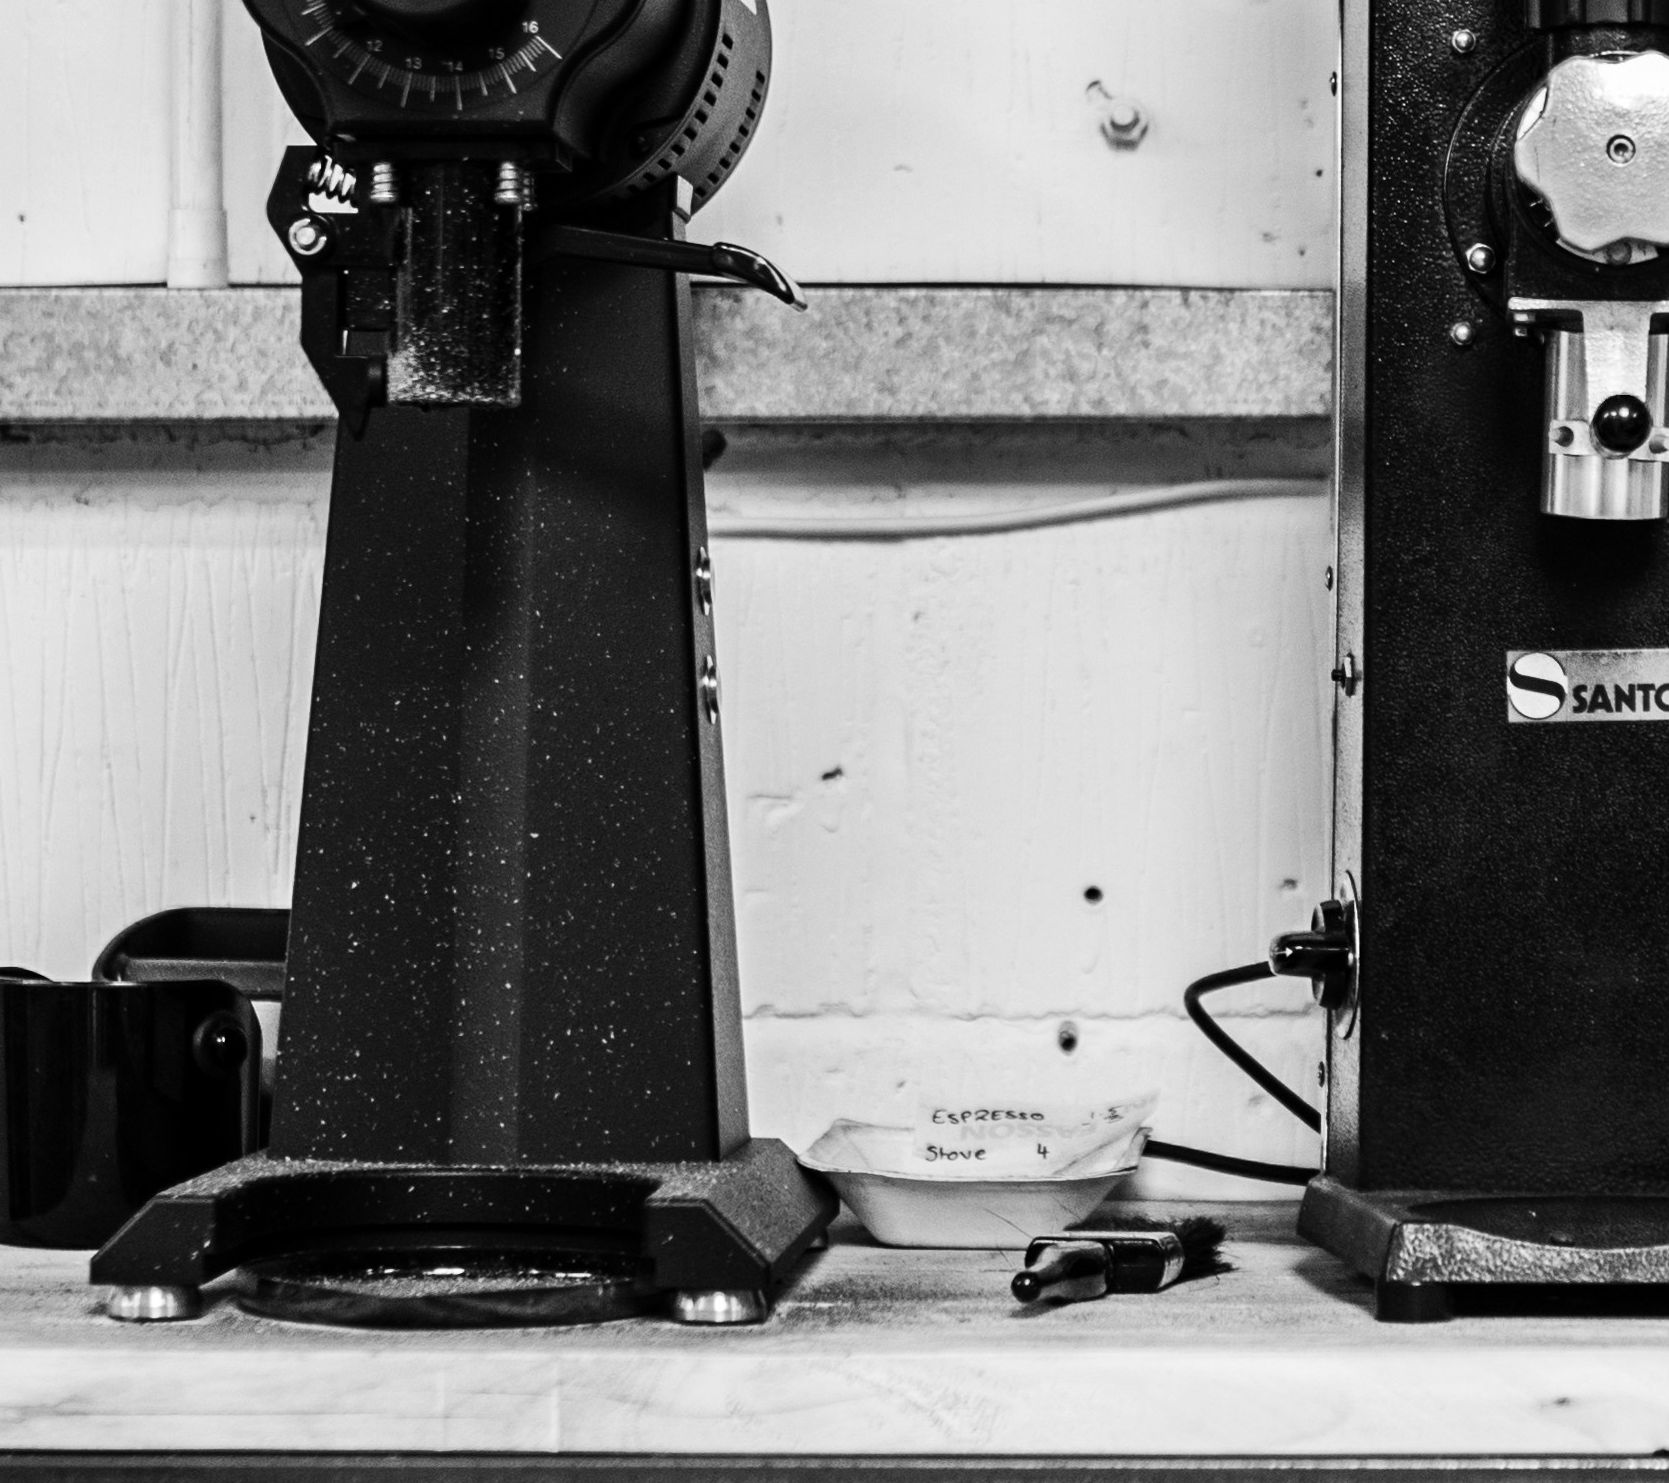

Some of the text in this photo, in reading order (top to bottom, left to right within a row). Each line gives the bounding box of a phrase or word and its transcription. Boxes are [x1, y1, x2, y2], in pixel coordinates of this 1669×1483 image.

[522, 20, 538, 33] 16
[489, 48, 504, 59] 15
[925, 1143, 1050, 1162] Stove 4
